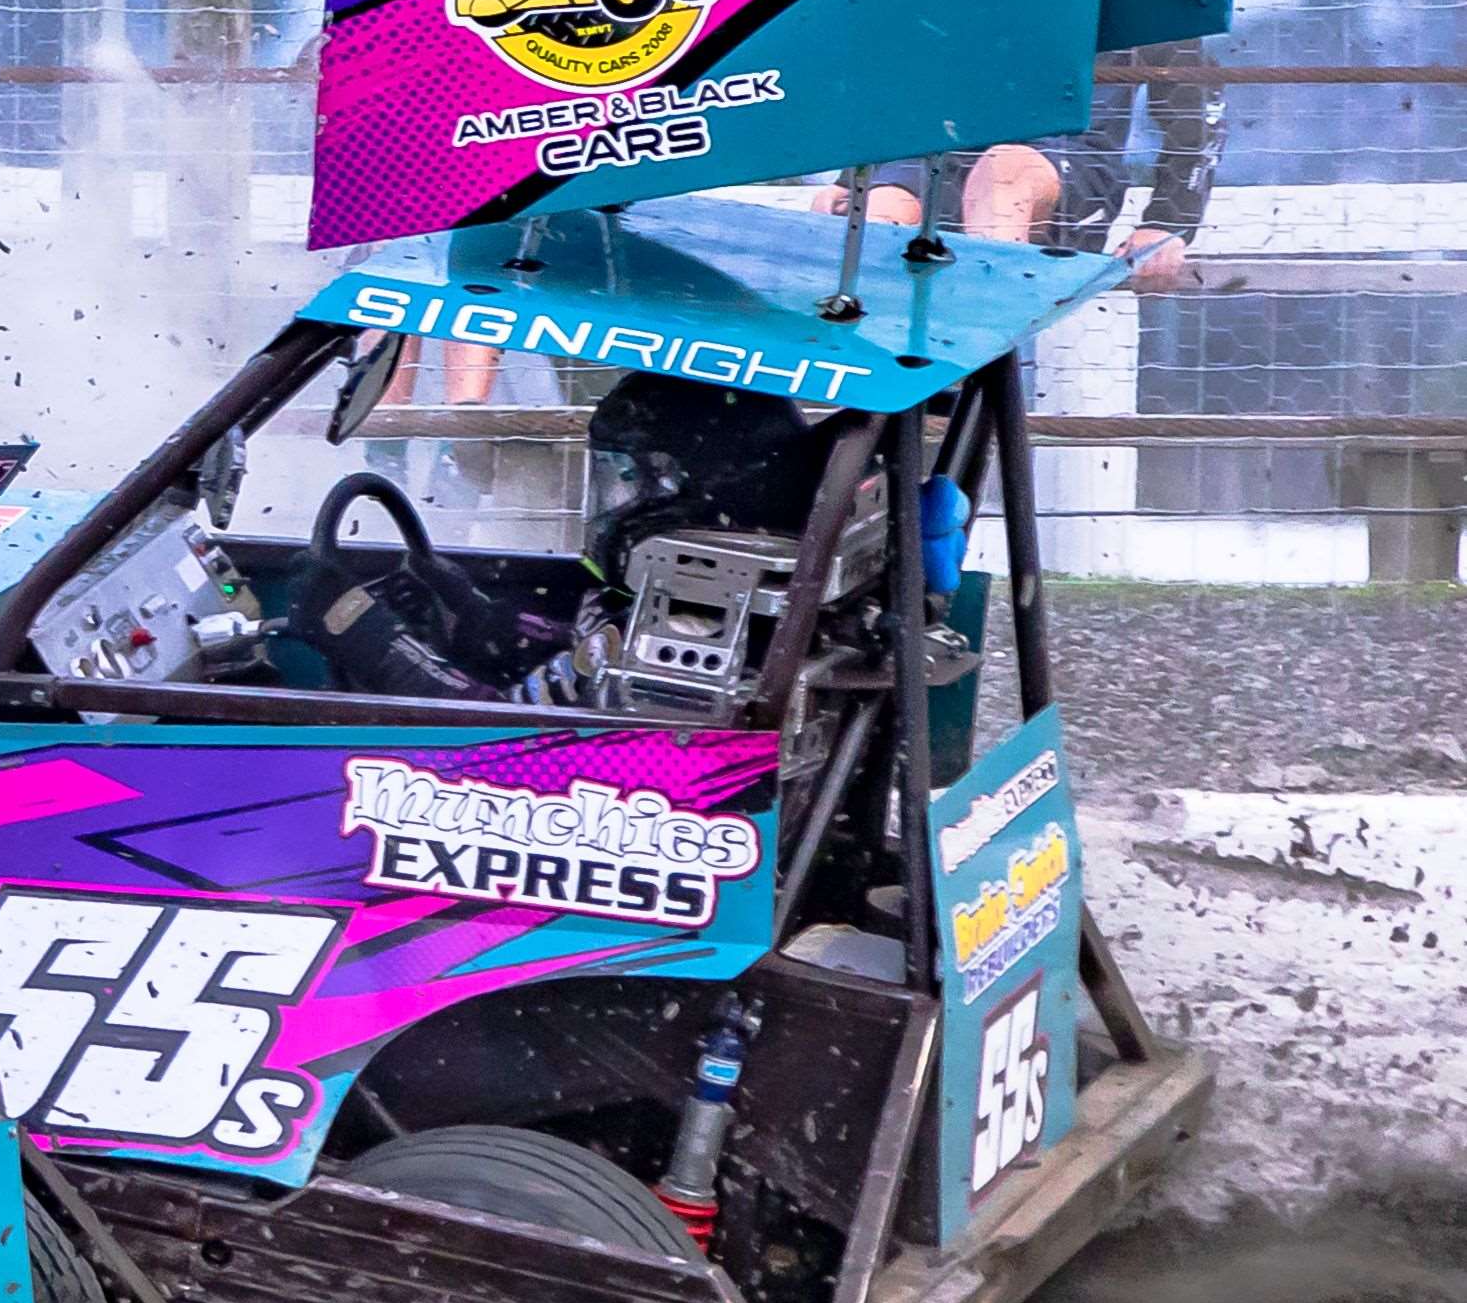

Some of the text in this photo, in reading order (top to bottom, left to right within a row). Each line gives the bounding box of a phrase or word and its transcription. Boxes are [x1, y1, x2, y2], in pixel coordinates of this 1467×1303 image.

[526, 23, 673, 74] QUALITY CARS 2008
[457, 75, 782, 143] AMBER & BLACK
[541, 120, 708, 172] CARS
[347, 286, 873, 400] SIGNRIGHT
[353, 765, 752, 869] Munchies
[381, 833, 707, 918] EXPRESS
[971, 989, 1048, 1193] 55s
